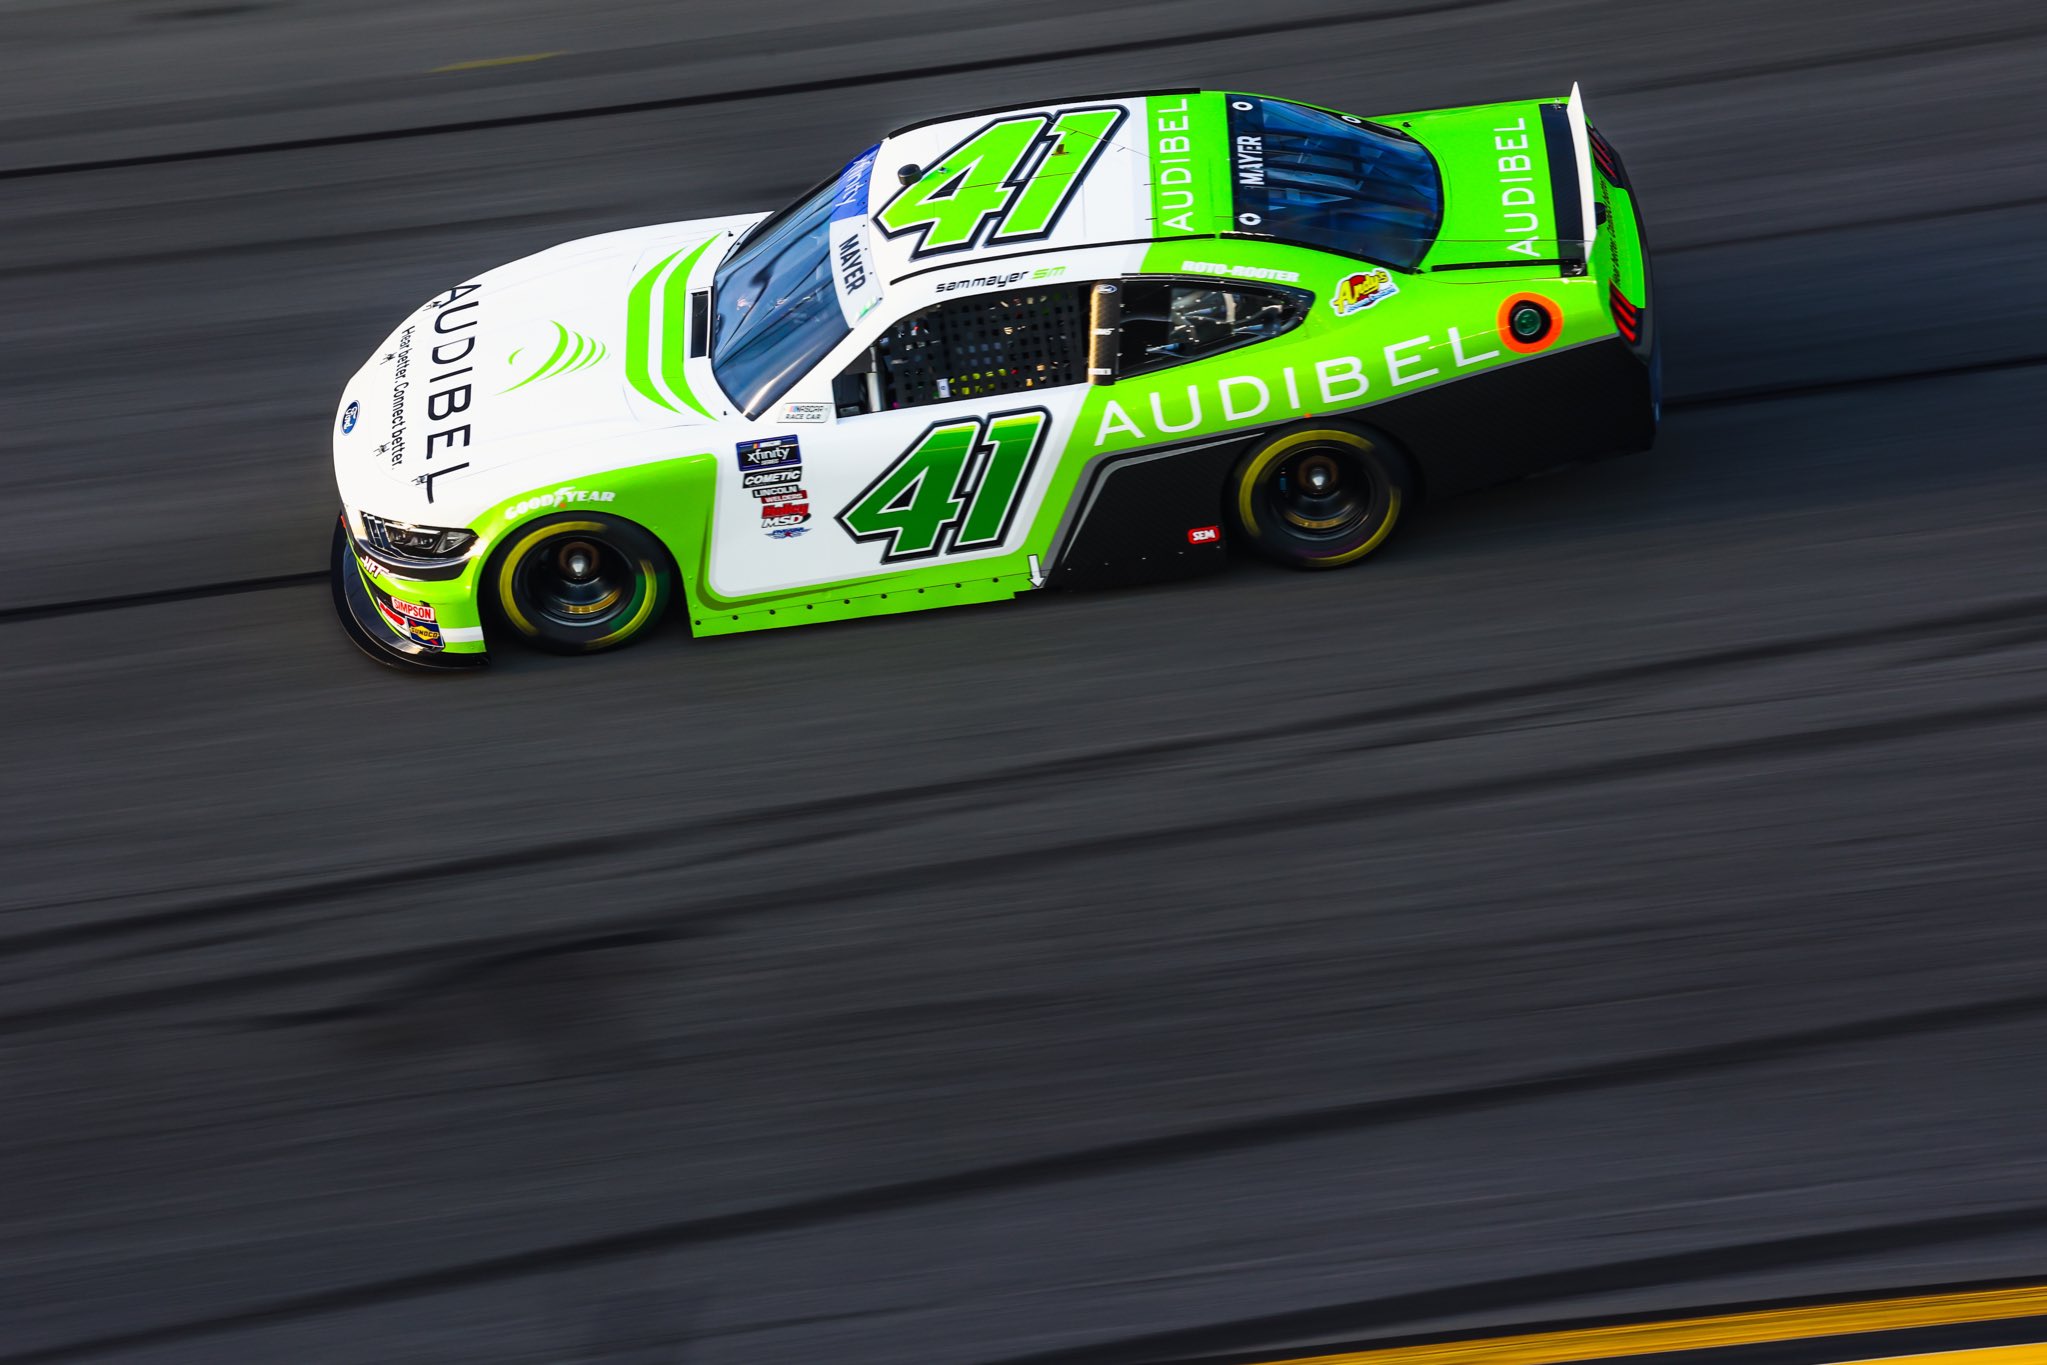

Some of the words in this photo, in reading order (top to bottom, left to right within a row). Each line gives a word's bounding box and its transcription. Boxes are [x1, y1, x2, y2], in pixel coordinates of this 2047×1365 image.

[1157, 98, 1195, 232] AUDIBEL
[1237, 135, 1265, 185] MAYER
[871, 104, 1130, 261] 41
[1493, 117, 1541, 257] AUDIBEL
[839, 233, 866, 295] MAYER
[1181, 260, 1301, 282] ROTO-ROOTER
[399, 325, 416, 350] Hear
[395, 347, 413, 383] better.
[426, 283, 483, 504] AUDIBEL
[1094, 326, 1501, 447] AUDIBEL
[391, 381, 409, 430] Connect
[747, 446, 790, 464] xfinity
[744, 470, 801, 485] COMETIC
[754, 486, 797, 497] LINCOLN
[834, 404, 1053, 565] 41
[504, 486, 616, 520] GOODYEAR
[761, 514, 804, 528] MSD
[1192, 529, 1216, 541] SEM
[393, 599, 432, 619] SIMPSON
[410, 626, 440, 639] SUNOCO
